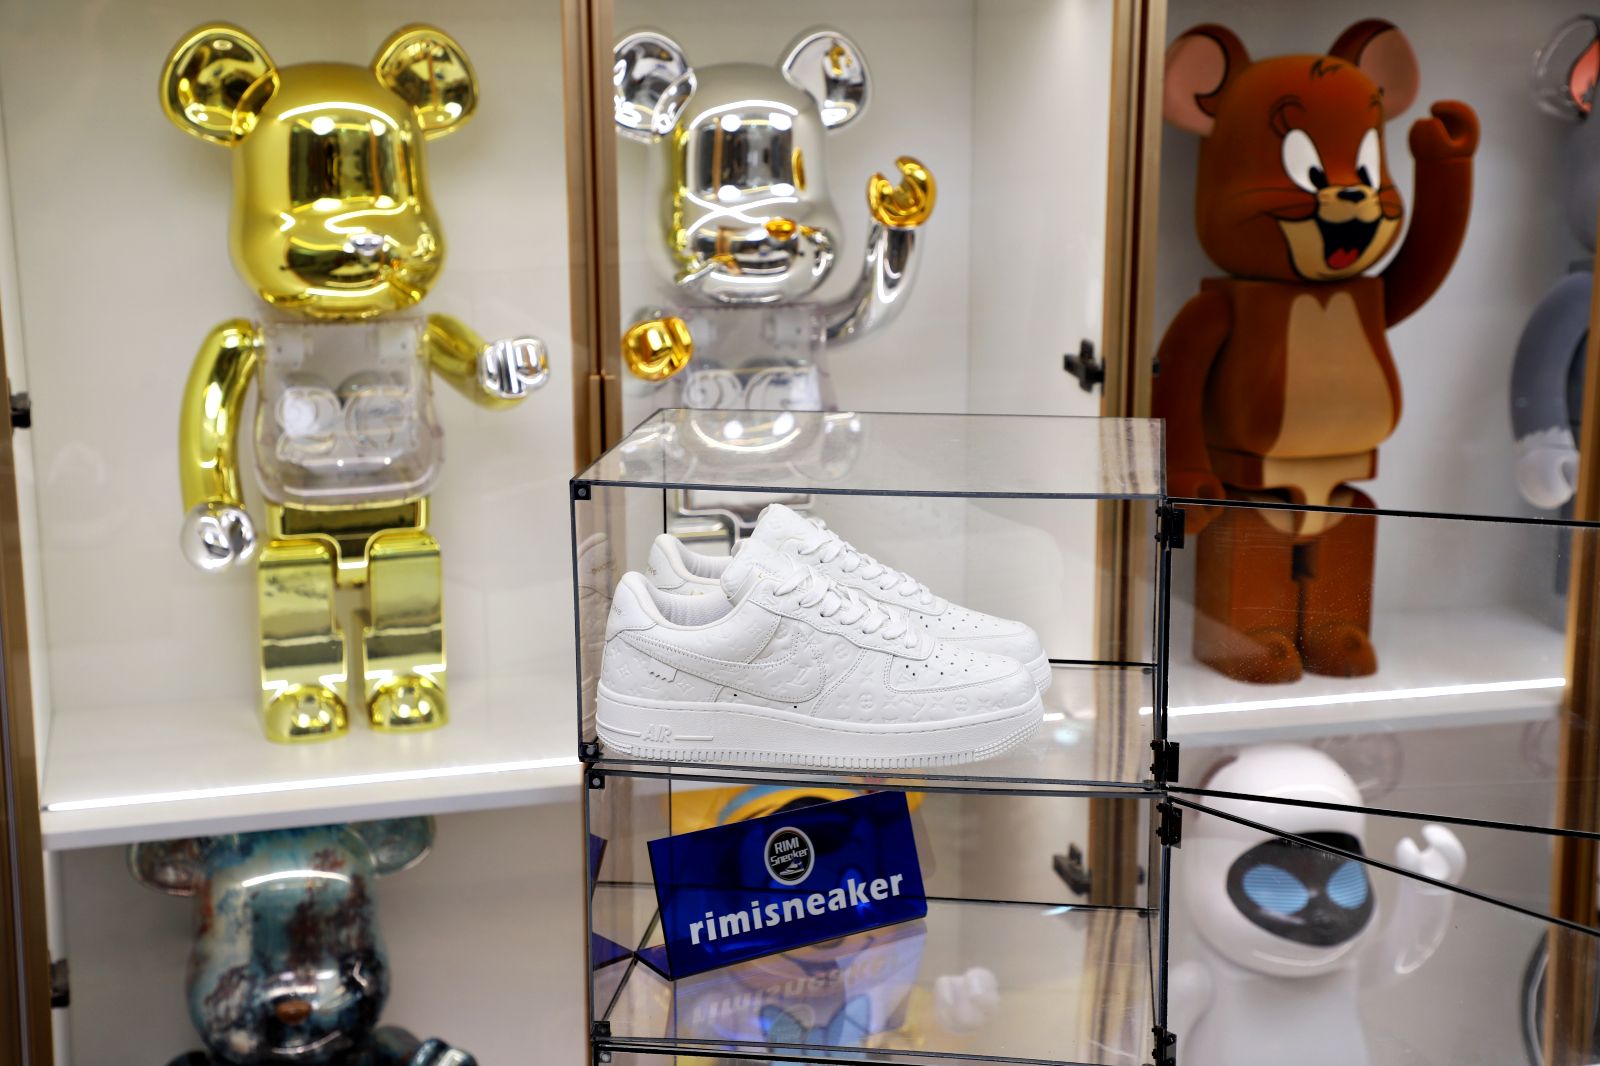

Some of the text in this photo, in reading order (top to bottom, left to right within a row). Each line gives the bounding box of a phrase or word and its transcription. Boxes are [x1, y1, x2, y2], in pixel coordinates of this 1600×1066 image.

[642, 723, 672, 743] AIR
[774, 836, 800, 854] RIMI
[770, 848, 809, 867] Sneaker
[689, 873, 903, 945] rimisneaker
